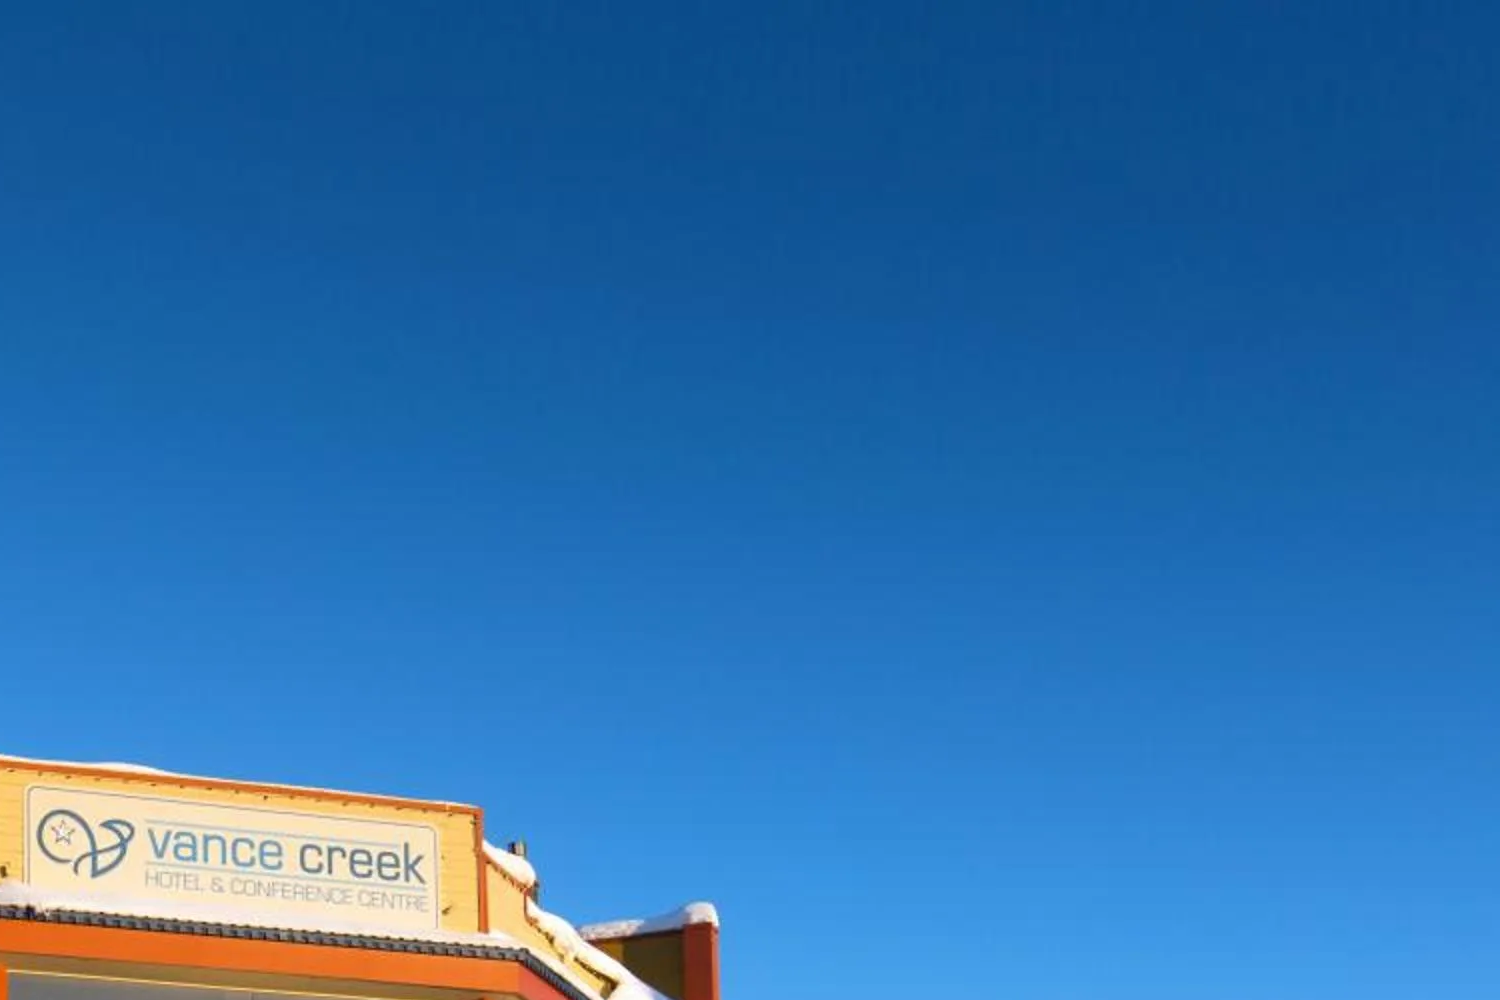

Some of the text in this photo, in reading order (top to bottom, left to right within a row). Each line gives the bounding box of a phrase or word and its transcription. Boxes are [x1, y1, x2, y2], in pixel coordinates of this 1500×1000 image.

[148, 828, 426, 884] vance creek
[145, 868, 430, 912] HOTEL & CONFERENCE CENTRE
